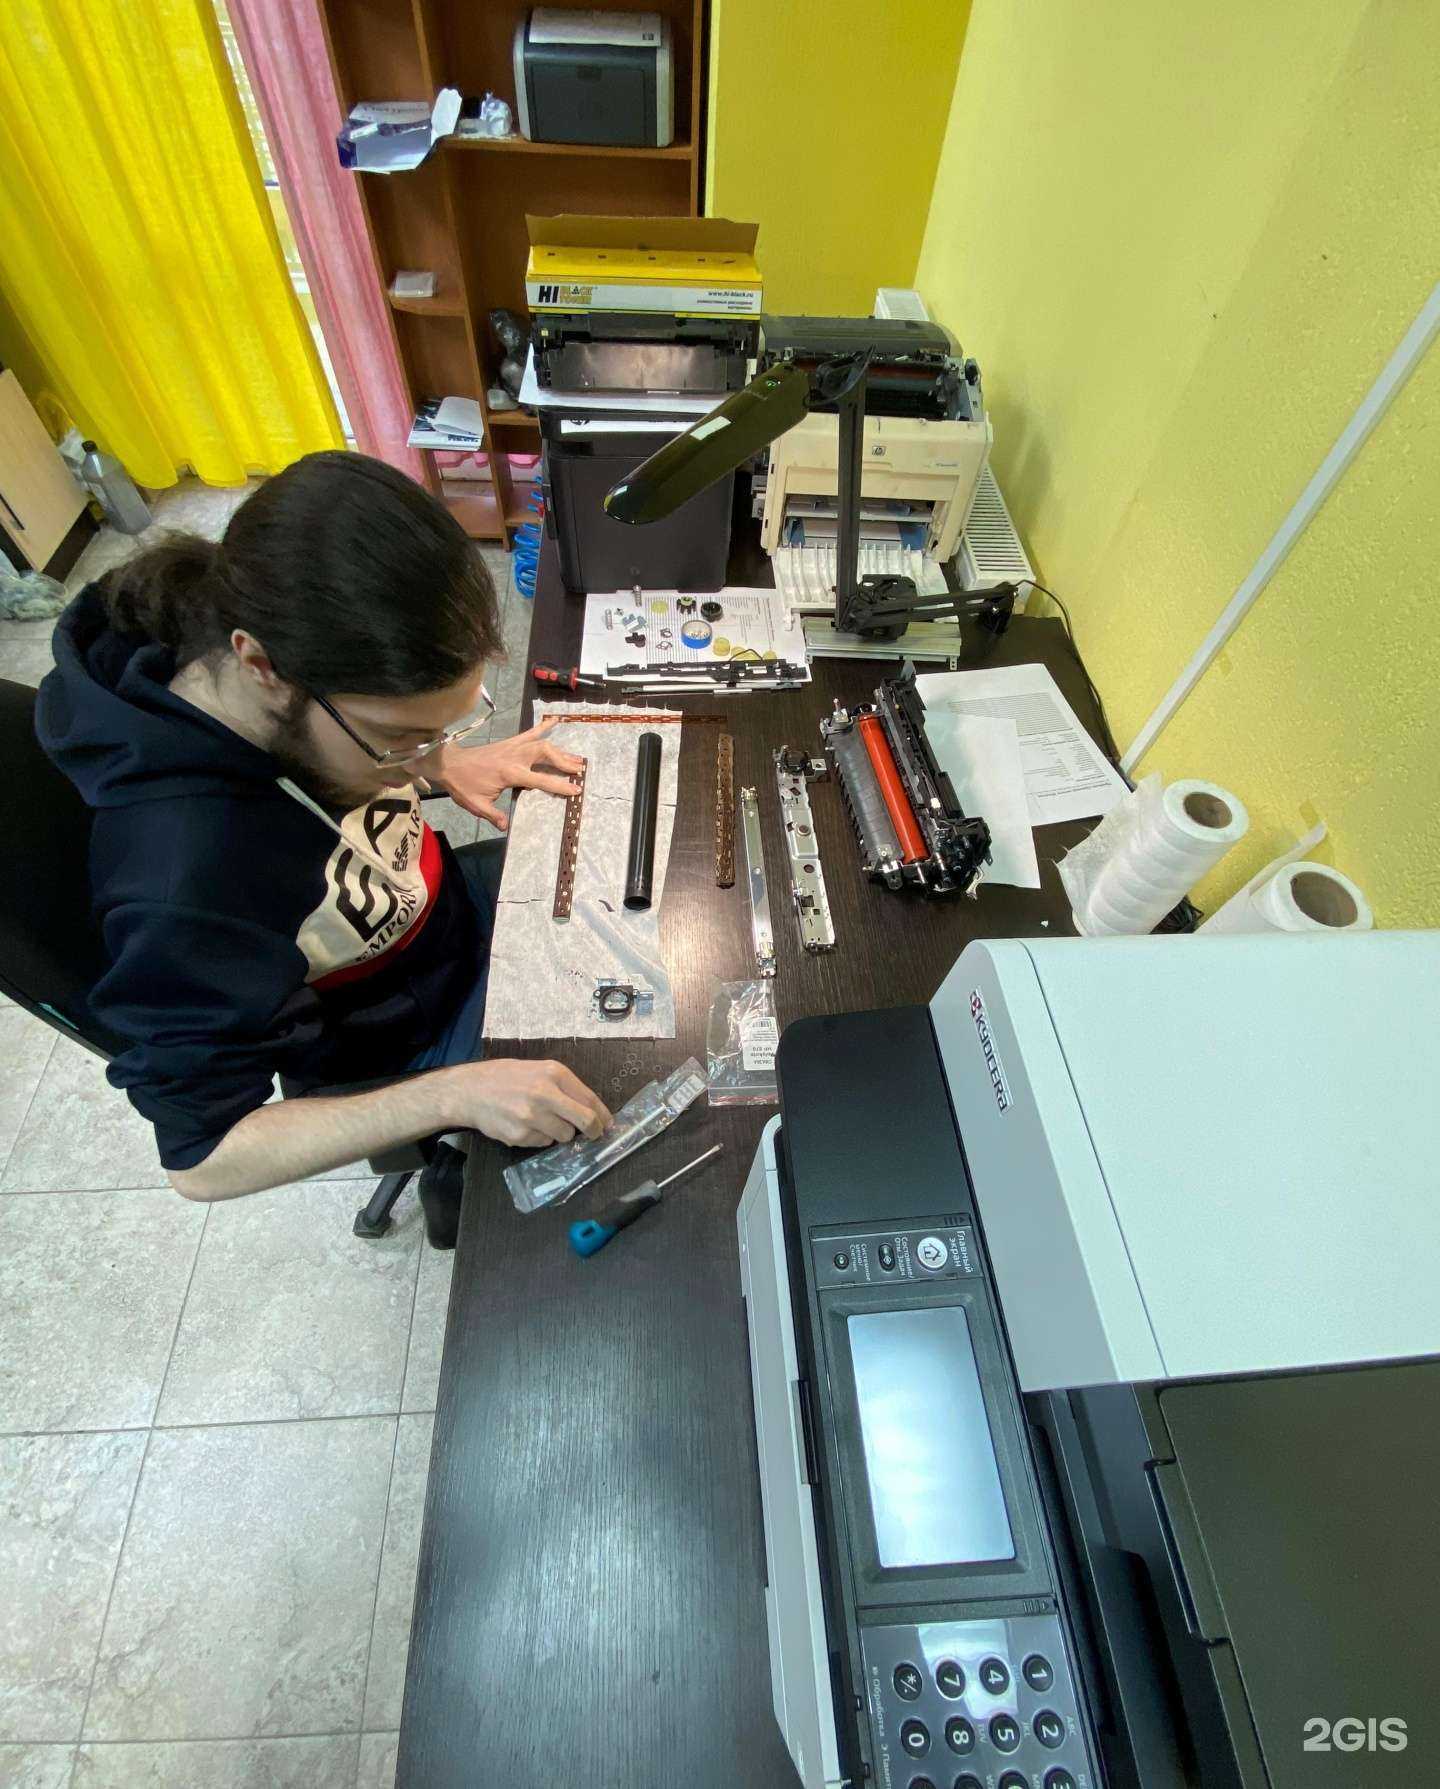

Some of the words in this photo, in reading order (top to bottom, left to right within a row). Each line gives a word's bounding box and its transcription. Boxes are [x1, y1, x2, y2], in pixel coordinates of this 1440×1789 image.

[538, 285, 560, 304] HI
[949, 1238, 962, 1267] экран
[957, 1230, 974, 1273] Главный
[943, 1673, 961, 1687] 7
[988, 1669, 1004, 1684] 4
[1031, 1668, 1048, 1679] 1
[1041, 1724, 1059, 1739] 2
[1066, 1715, 1078, 1737] ABC
[908, 1733, 925, 1747] 0
[952, 1730, 969, 1745] 8
[997, 1728, 1015, 1741] 5
